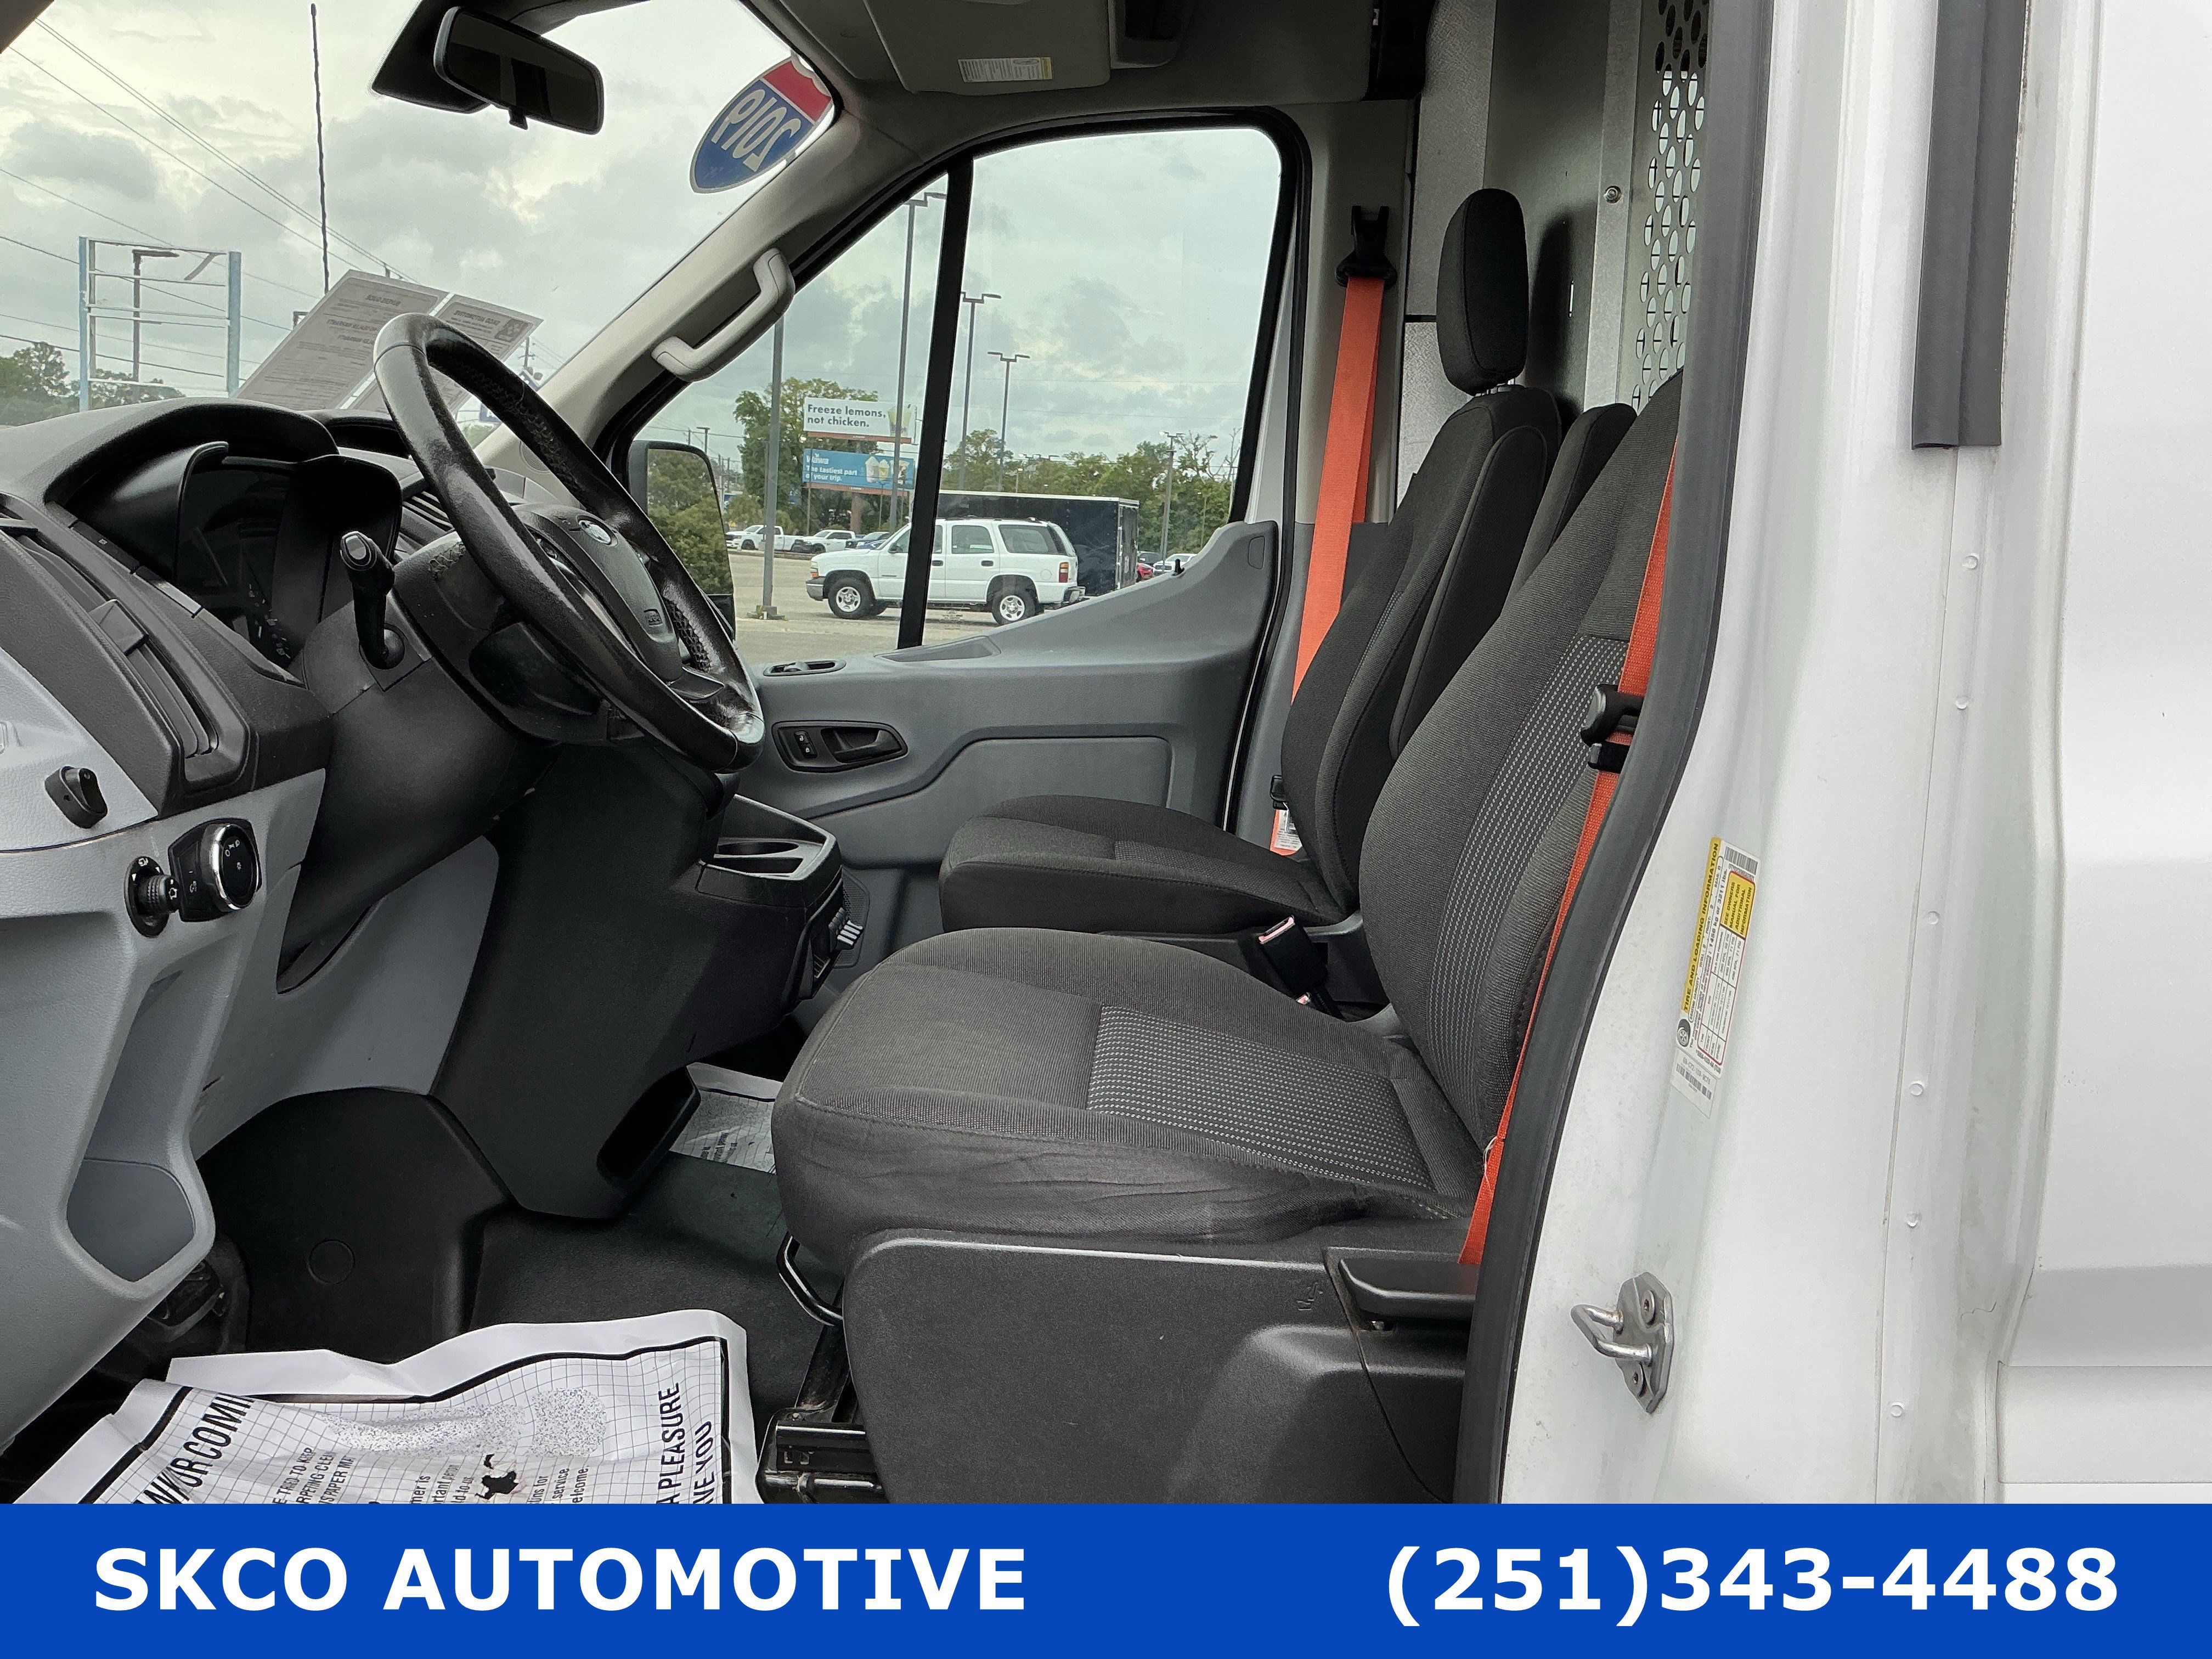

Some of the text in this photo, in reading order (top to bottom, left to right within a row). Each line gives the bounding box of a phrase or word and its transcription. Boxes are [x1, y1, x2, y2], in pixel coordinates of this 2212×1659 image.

[808, 404, 886, 419] Freeze lemons,
[827, 416, 870, 427] chicken.
[1729, 898, 1737, 929] MANUAL
[1734, 888, 1746, 930] ADDITIONAL
[1739, 885, 1752, 935] INFORMATION
[1683, 987, 1691, 1012] TIRE
[1692, 916, 1705, 962] LOADING
[1701, 842, 1718, 915] INFORMATION
[657, 1383, 686, 1490] PLEASURE
[695, 1421, 714, 1475] YOU
[289, 1465, 307, 1476] TO
[296, 1447, 317, 1464] KEEP
[295, 1473, 325, 1504] RPETING
[325, 1471, 348, 1497] PAPER
[337, 1455, 356, 1469] MA
[415, 1475, 431, 1483] is
[455, 1485, 471, 1493] to
[533, 1475, 549, 1487] for
[551, 1468, 570, 1499] service
[570, 1465, 590, 1503] elcome.
[432, 1480, 451, 1504] rtant
